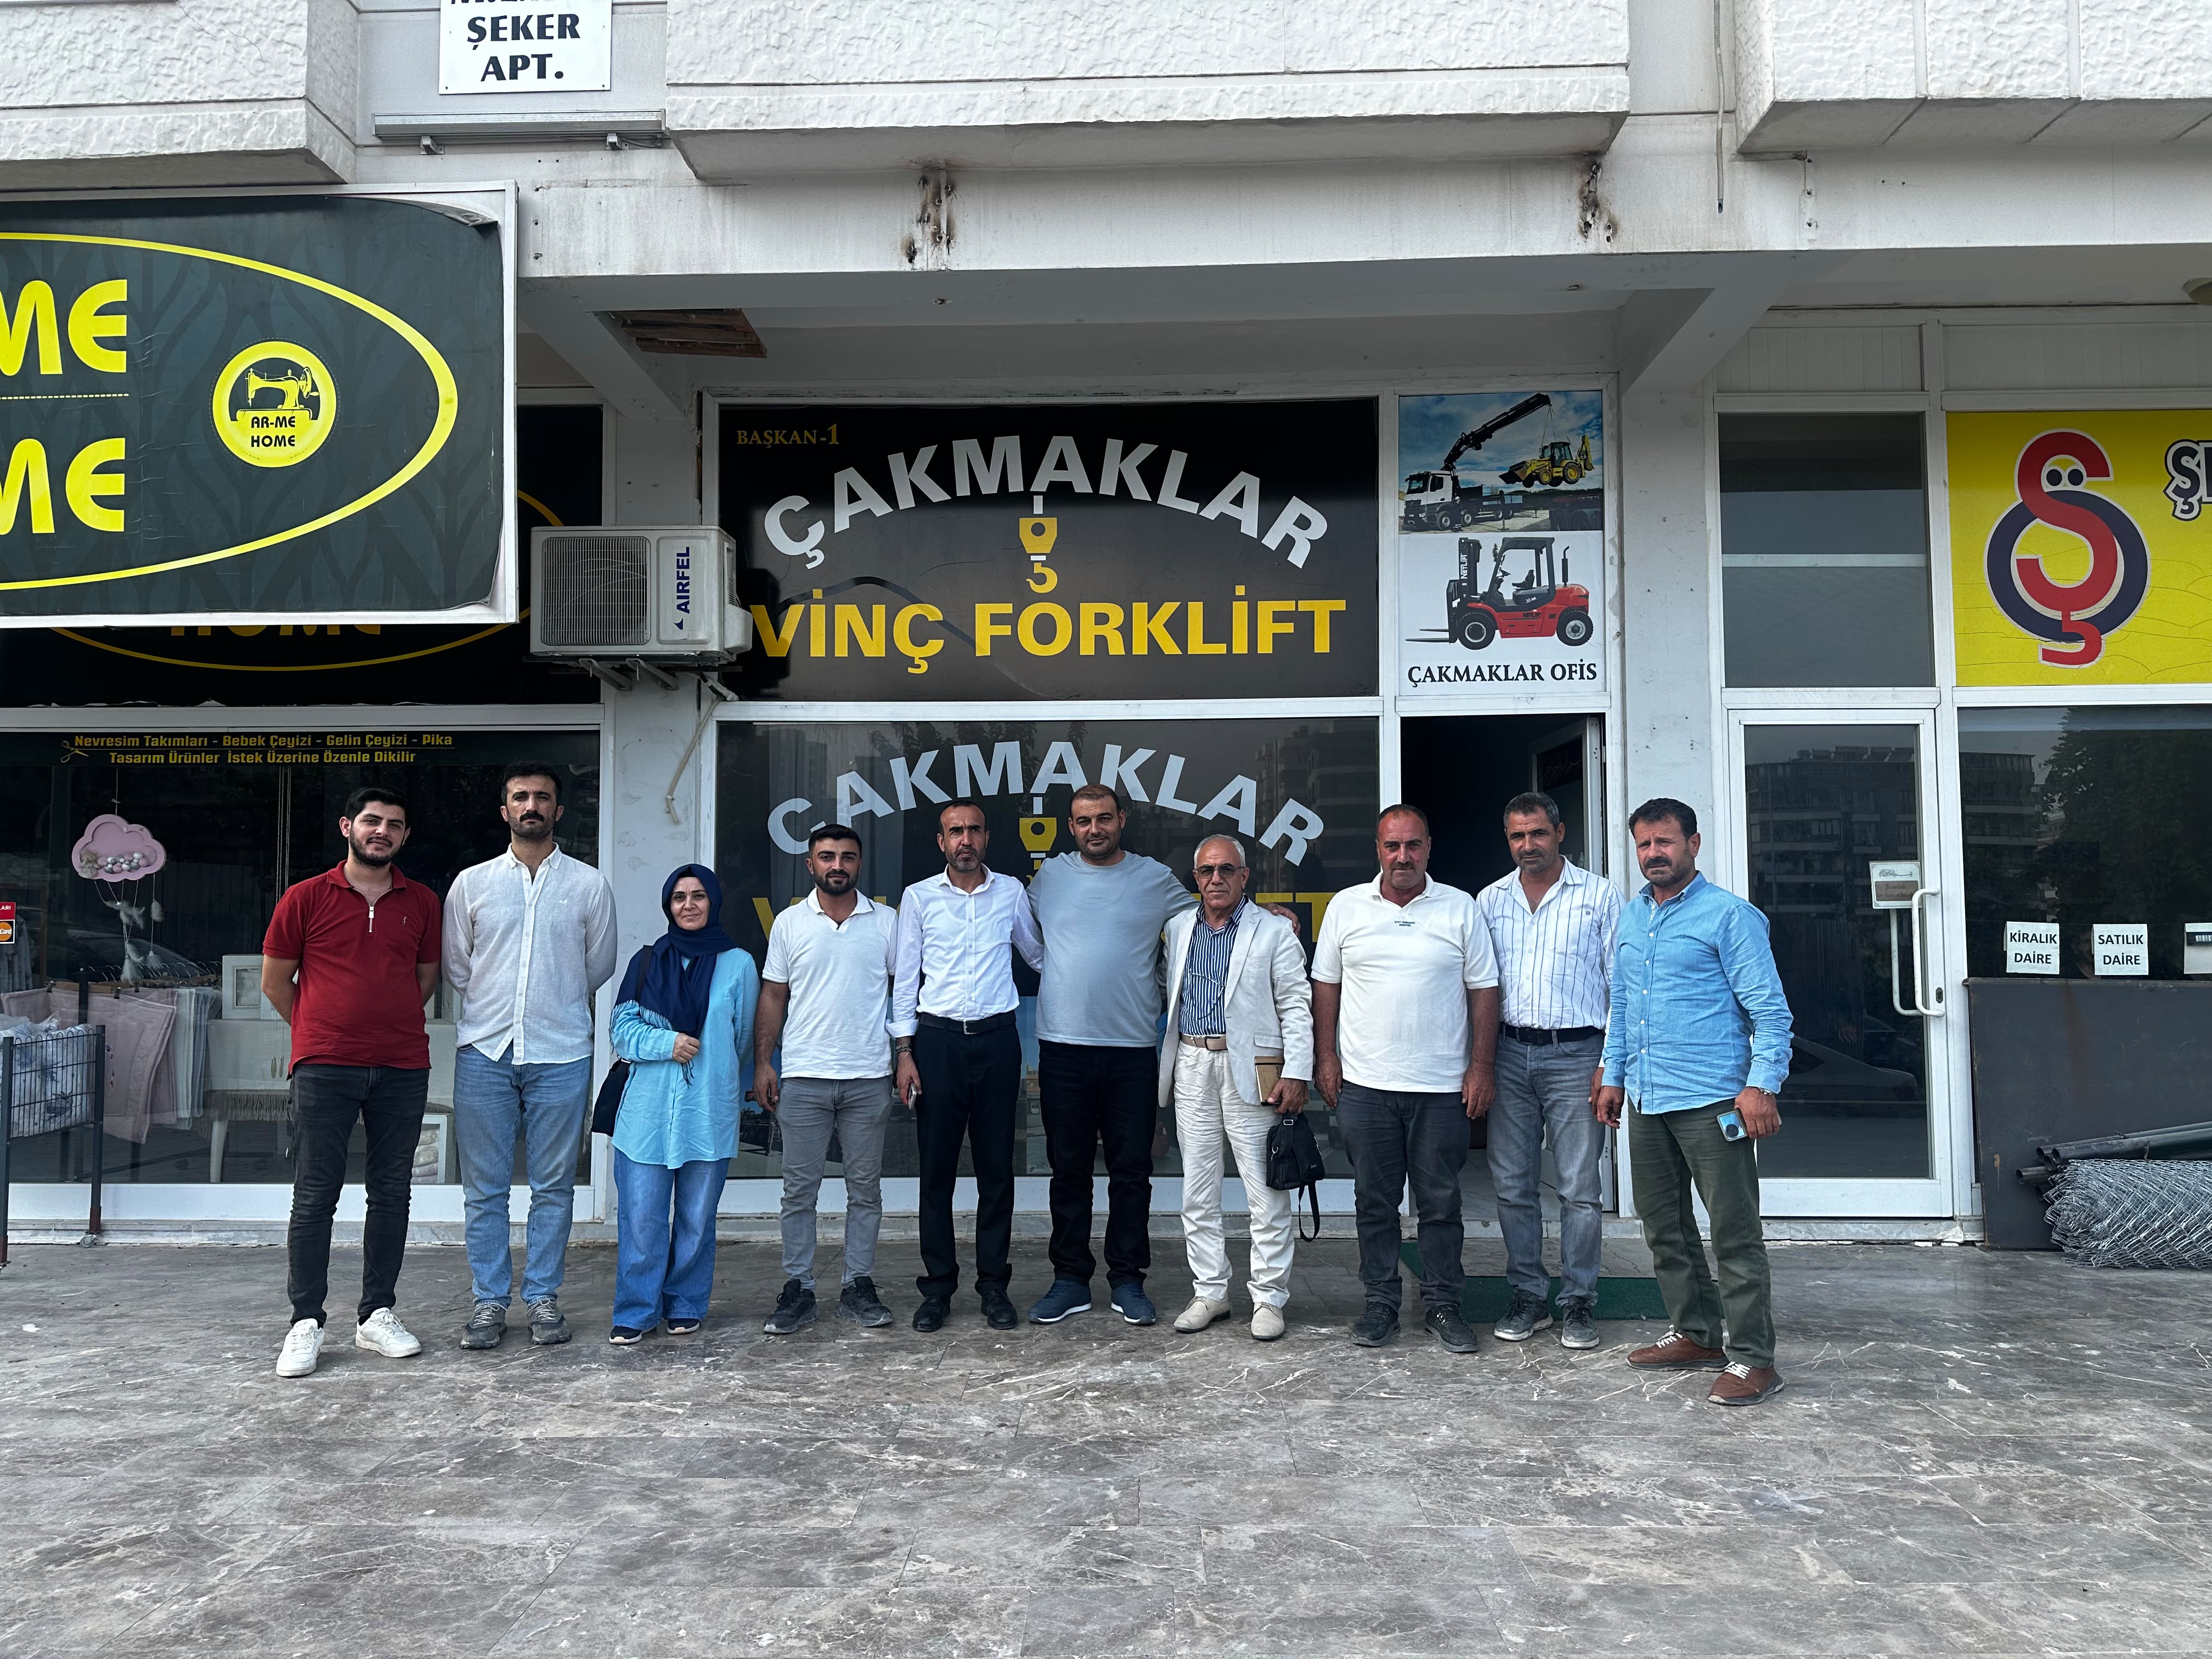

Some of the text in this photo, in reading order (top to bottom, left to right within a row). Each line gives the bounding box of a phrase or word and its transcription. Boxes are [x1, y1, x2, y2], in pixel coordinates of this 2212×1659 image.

[467, 14, 581, 50] ŞEKER
[481, 53, 563, 82] APT.
[251, 416, 295, 428] AR-ME
[251, 435, 295, 447] HOME
[737, 424, 839, 448] BAŞKAN-1
[764, 435, 1328, 569] ÇAKMAKLAR
[676, 547, 690, 613] AIRFEL
[751, 585, 1346, 674] VİNÇ FORKLİFT
[1408, 658, 1597, 687] ÇAKMAKLAR OFİS
[75, 736, 139, 747] Nevresim
[144, 736, 207, 747] Takımları
[223, 735, 266, 746] Bebek
[270, 735, 311, 748] Çeyizi
[326, 735, 361, 746] Gelin
[365, 734, 407, 747] Çeyizi
[422, 734, 452, 746] Pika
[110, 749, 416, 763] Tasarım Ürünler İstek Üzerine Özenle Dikilir
[2010, 930, 2057, 944] KİRALIK
[2098, 934, 2143, 945] SATILIK
[2015, 951, 2052, 964] DAİRE
[2103, 952, 2141, 966] DAİRE
